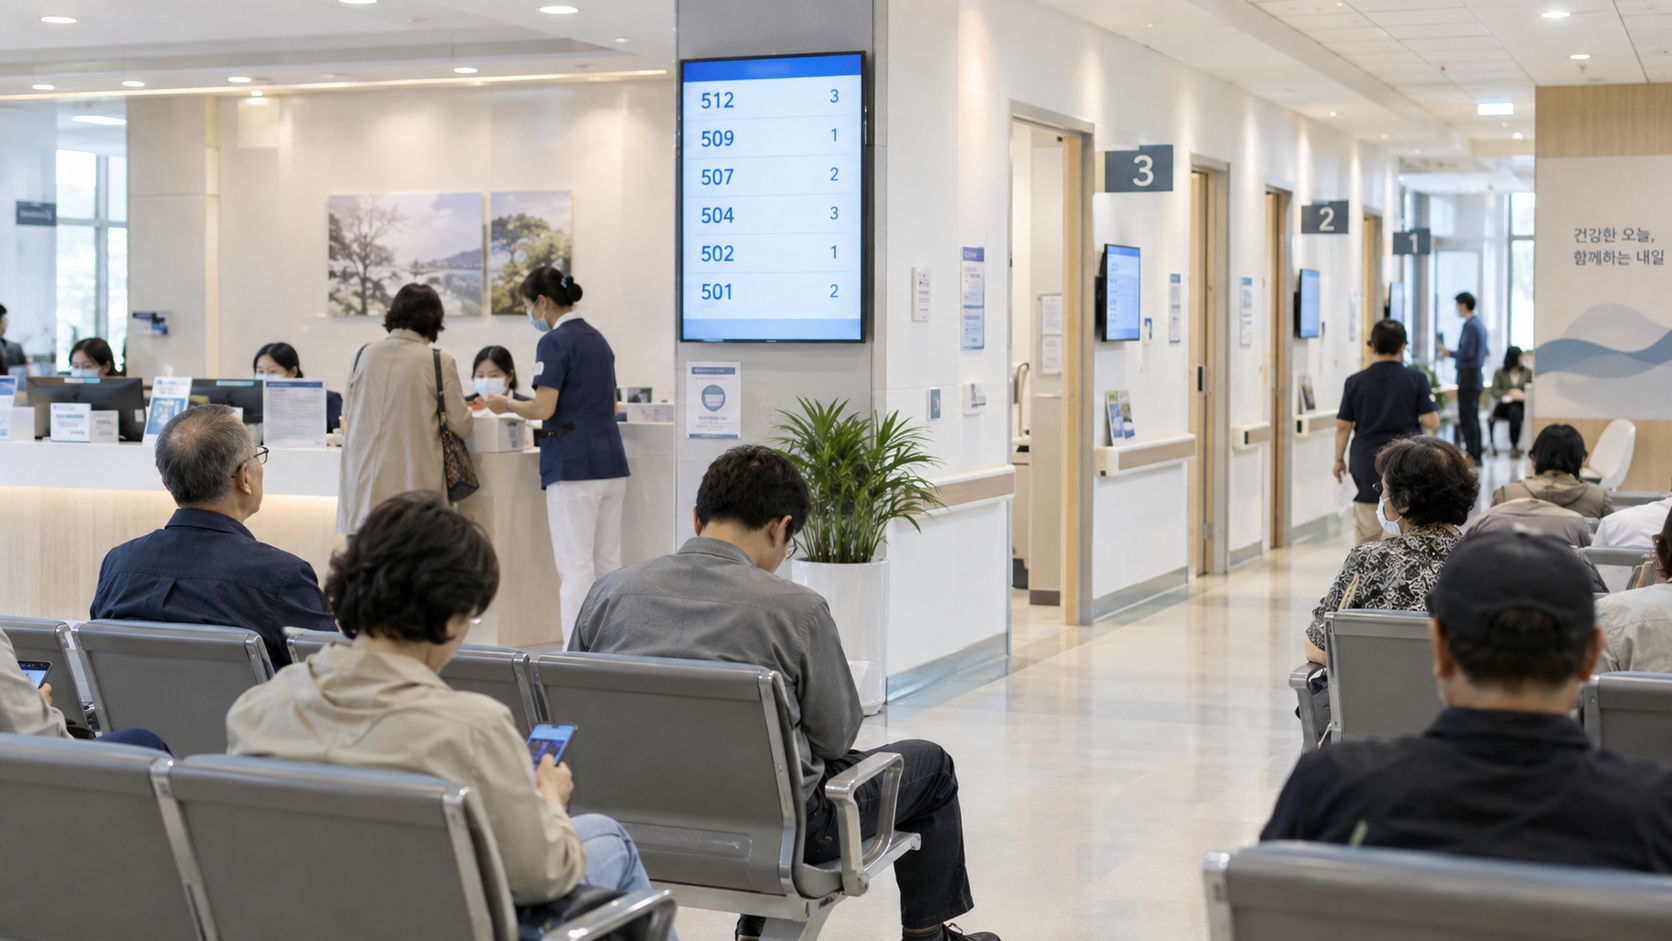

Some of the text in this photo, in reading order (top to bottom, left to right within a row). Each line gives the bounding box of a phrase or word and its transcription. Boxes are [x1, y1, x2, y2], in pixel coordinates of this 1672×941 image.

[701, 88, 839, 109] 512 3
[701, 128, 837, 148] 509 1
[701, 167, 839, 186] 507 2
[1132, 154, 1154, 187] 3
[701, 206, 839, 224] 504 3
[1319, 207, 1335, 231] 2
[1408, 232, 1419, 254] 1
[1574, 227, 1655, 244] 건강한 오늘,
[701, 245, 837, 262] 502 1
[1574, 249, 1665, 266] 함께하는 내일
[701, 283, 839, 300] 501 2
